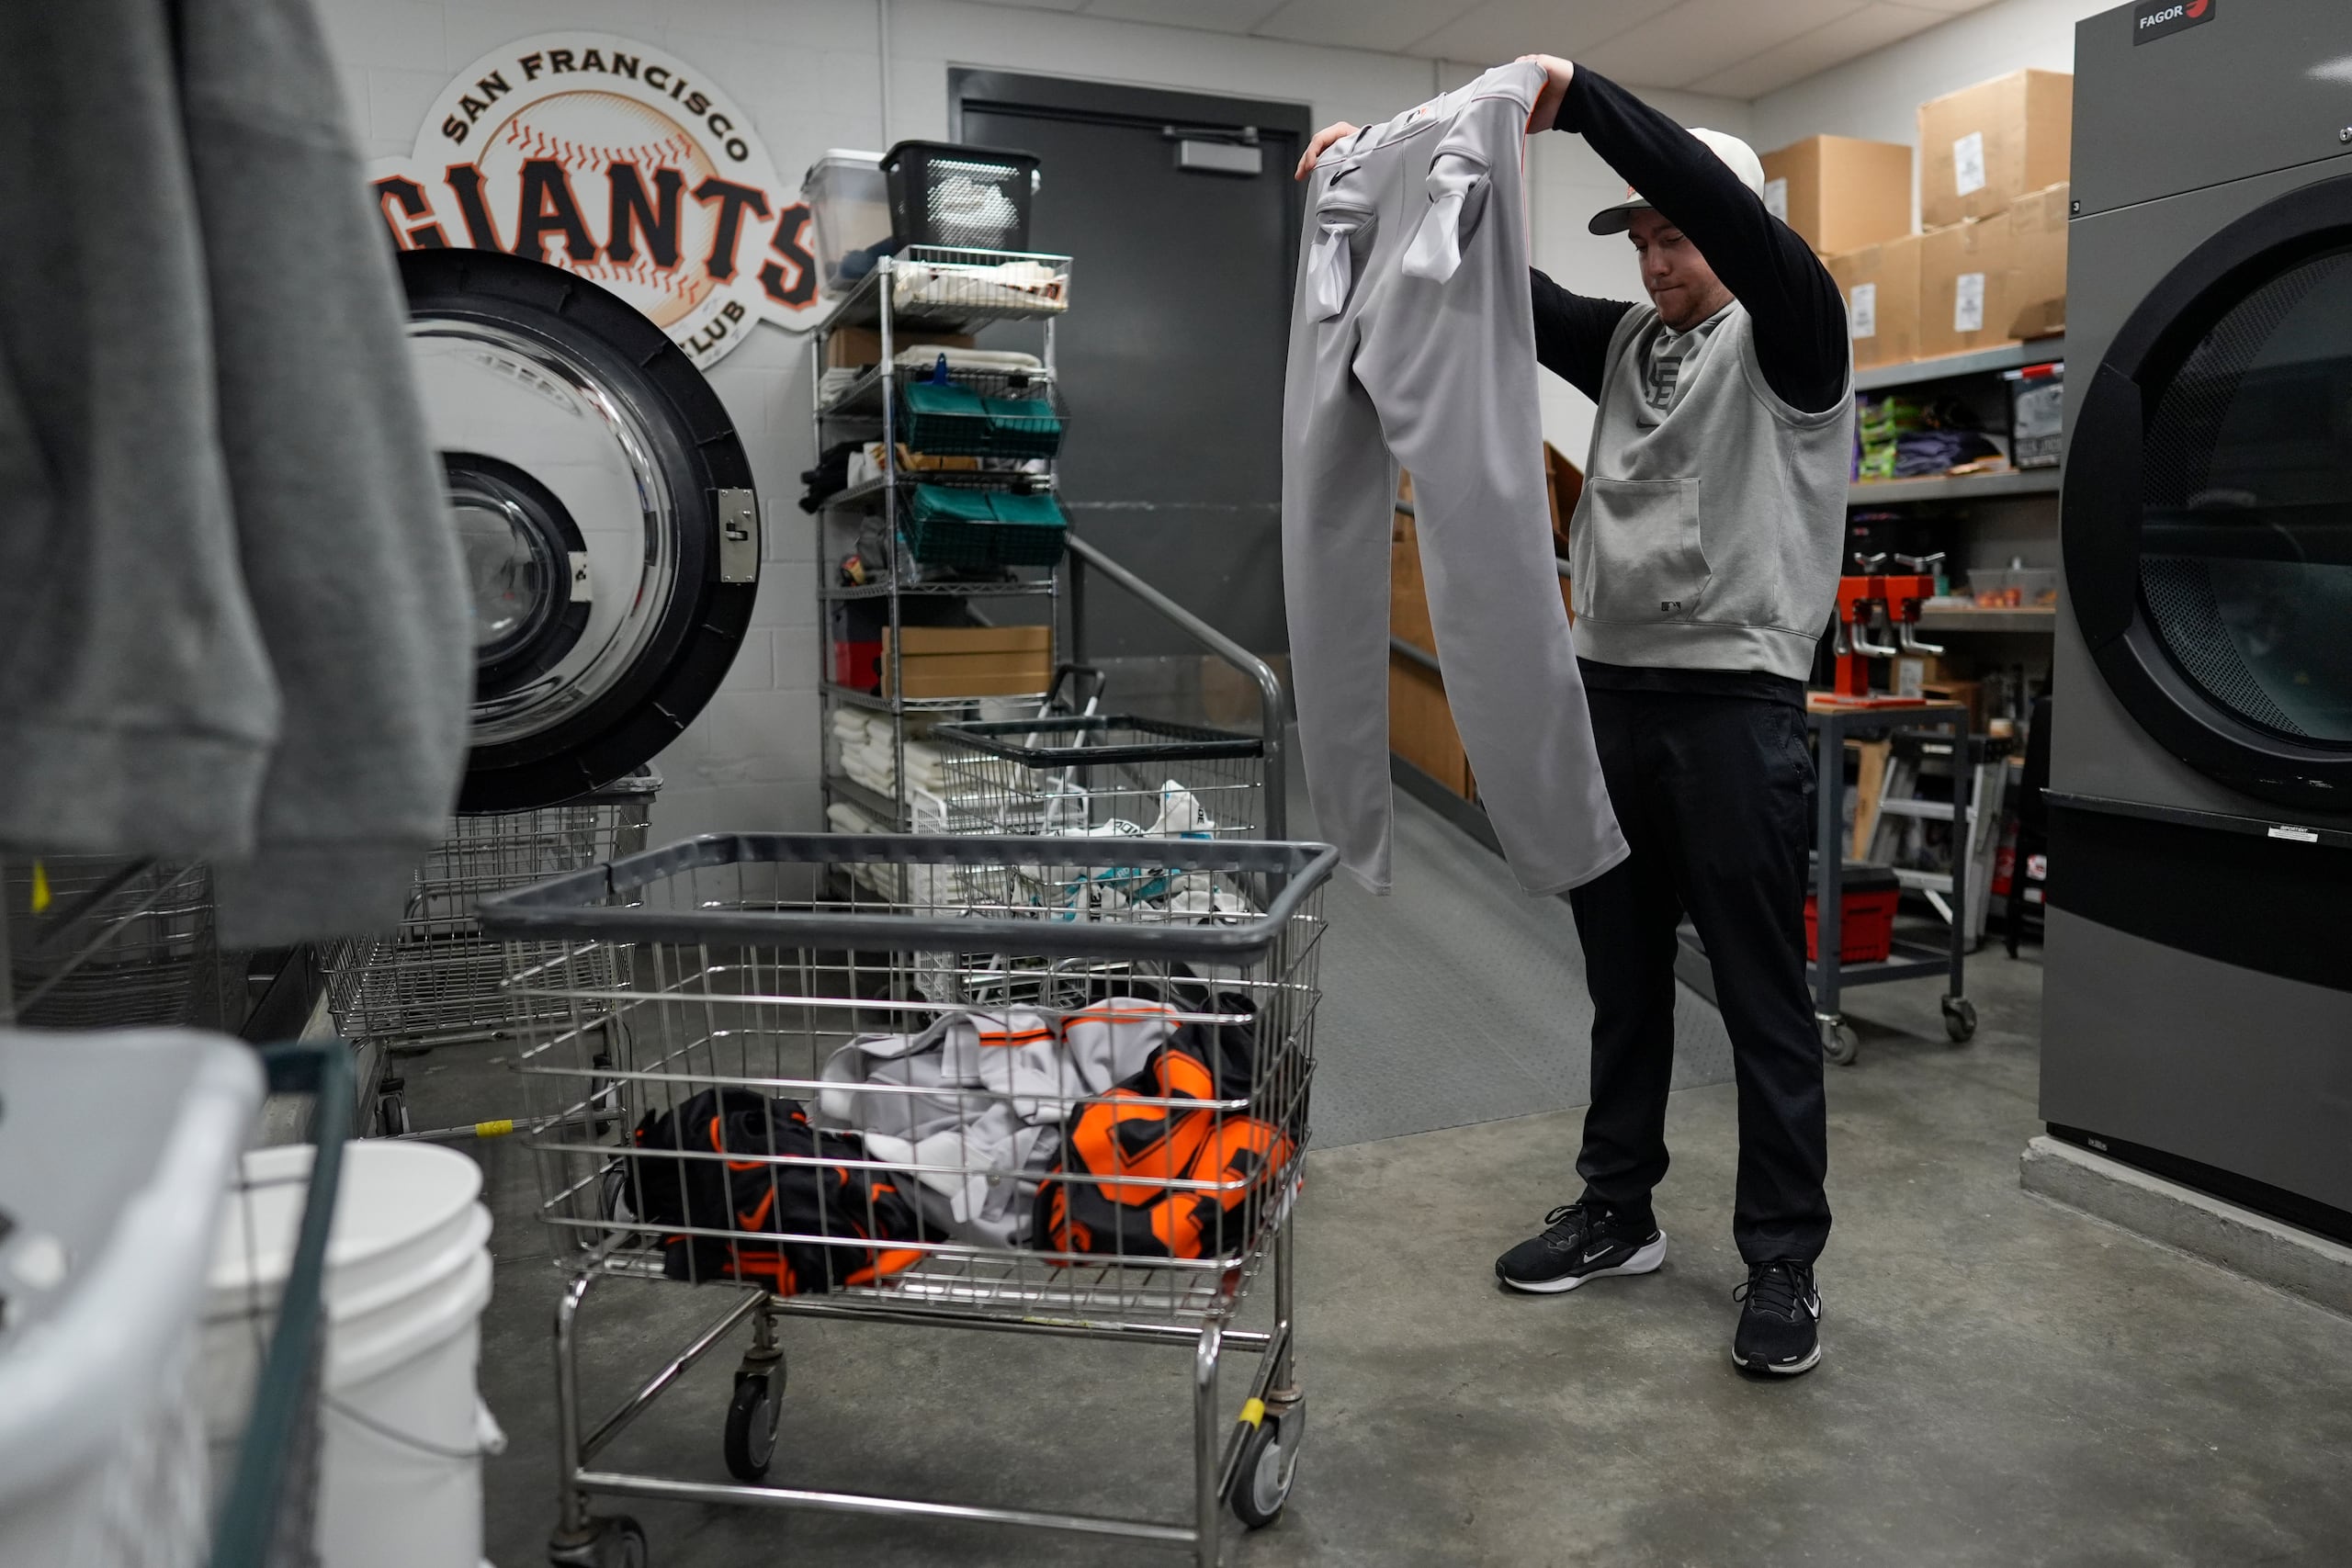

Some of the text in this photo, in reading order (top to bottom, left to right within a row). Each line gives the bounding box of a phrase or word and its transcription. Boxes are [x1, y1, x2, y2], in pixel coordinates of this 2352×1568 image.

[2140, 6, 2183, 29] FAGOR
[442, 49, 750, 162] SAN FRANCISCO
[679, 300, 746, 359] LUB
